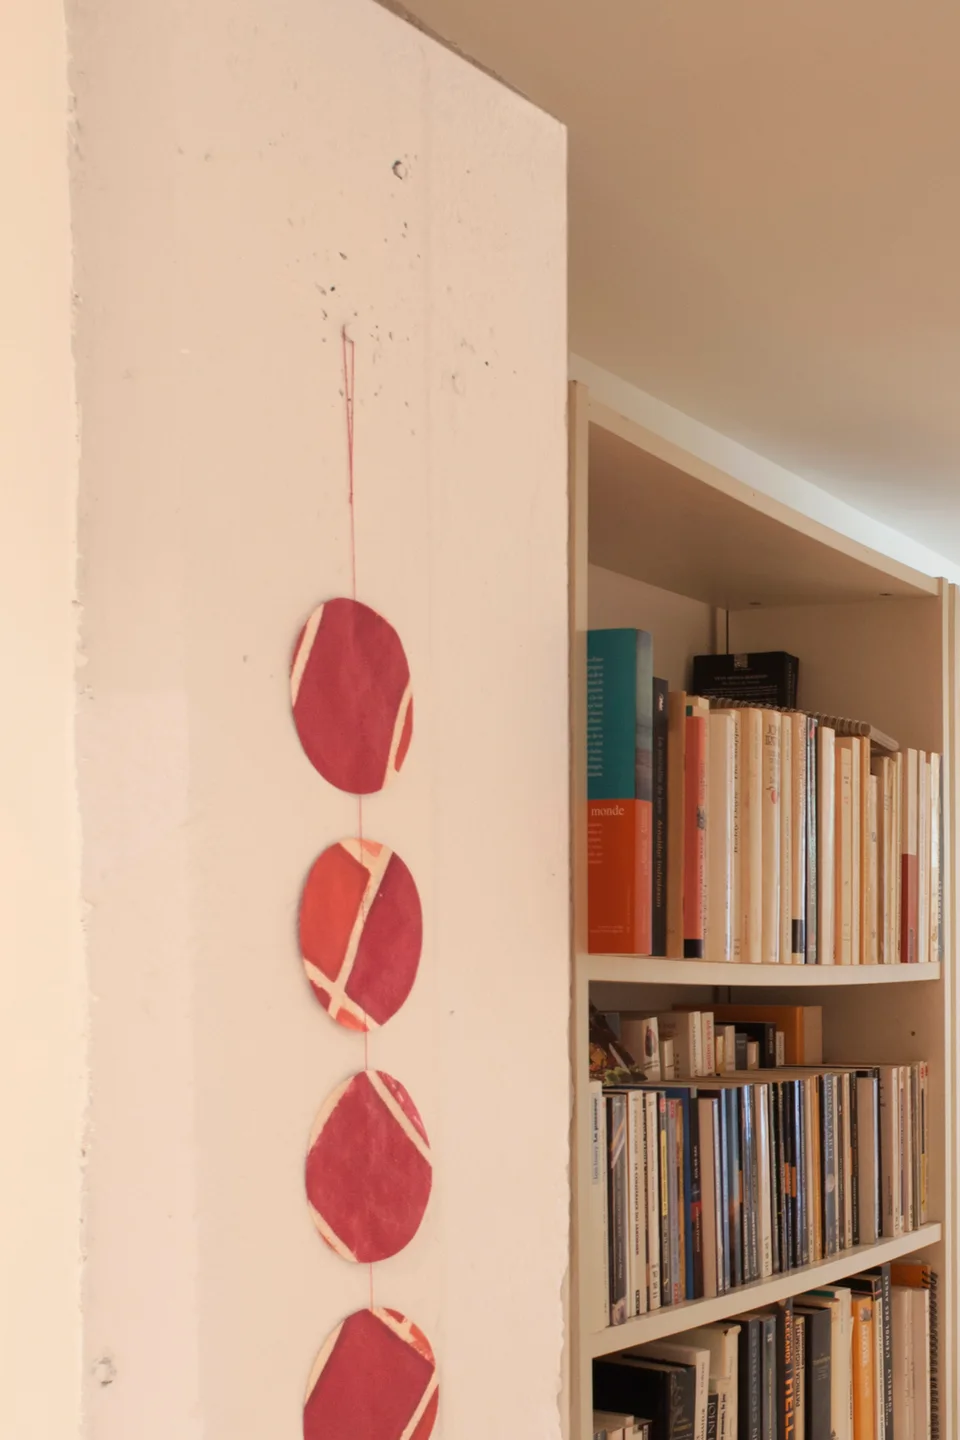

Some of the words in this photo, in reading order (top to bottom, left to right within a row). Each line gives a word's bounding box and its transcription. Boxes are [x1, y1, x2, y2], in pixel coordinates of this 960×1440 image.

[591, 804, 625, 817] monde
[750, 1327, 758, 1424] CICATRICES
[706, 1401, 715, 1435] JOHN
[784, 1377, 794, 1440] HELL
